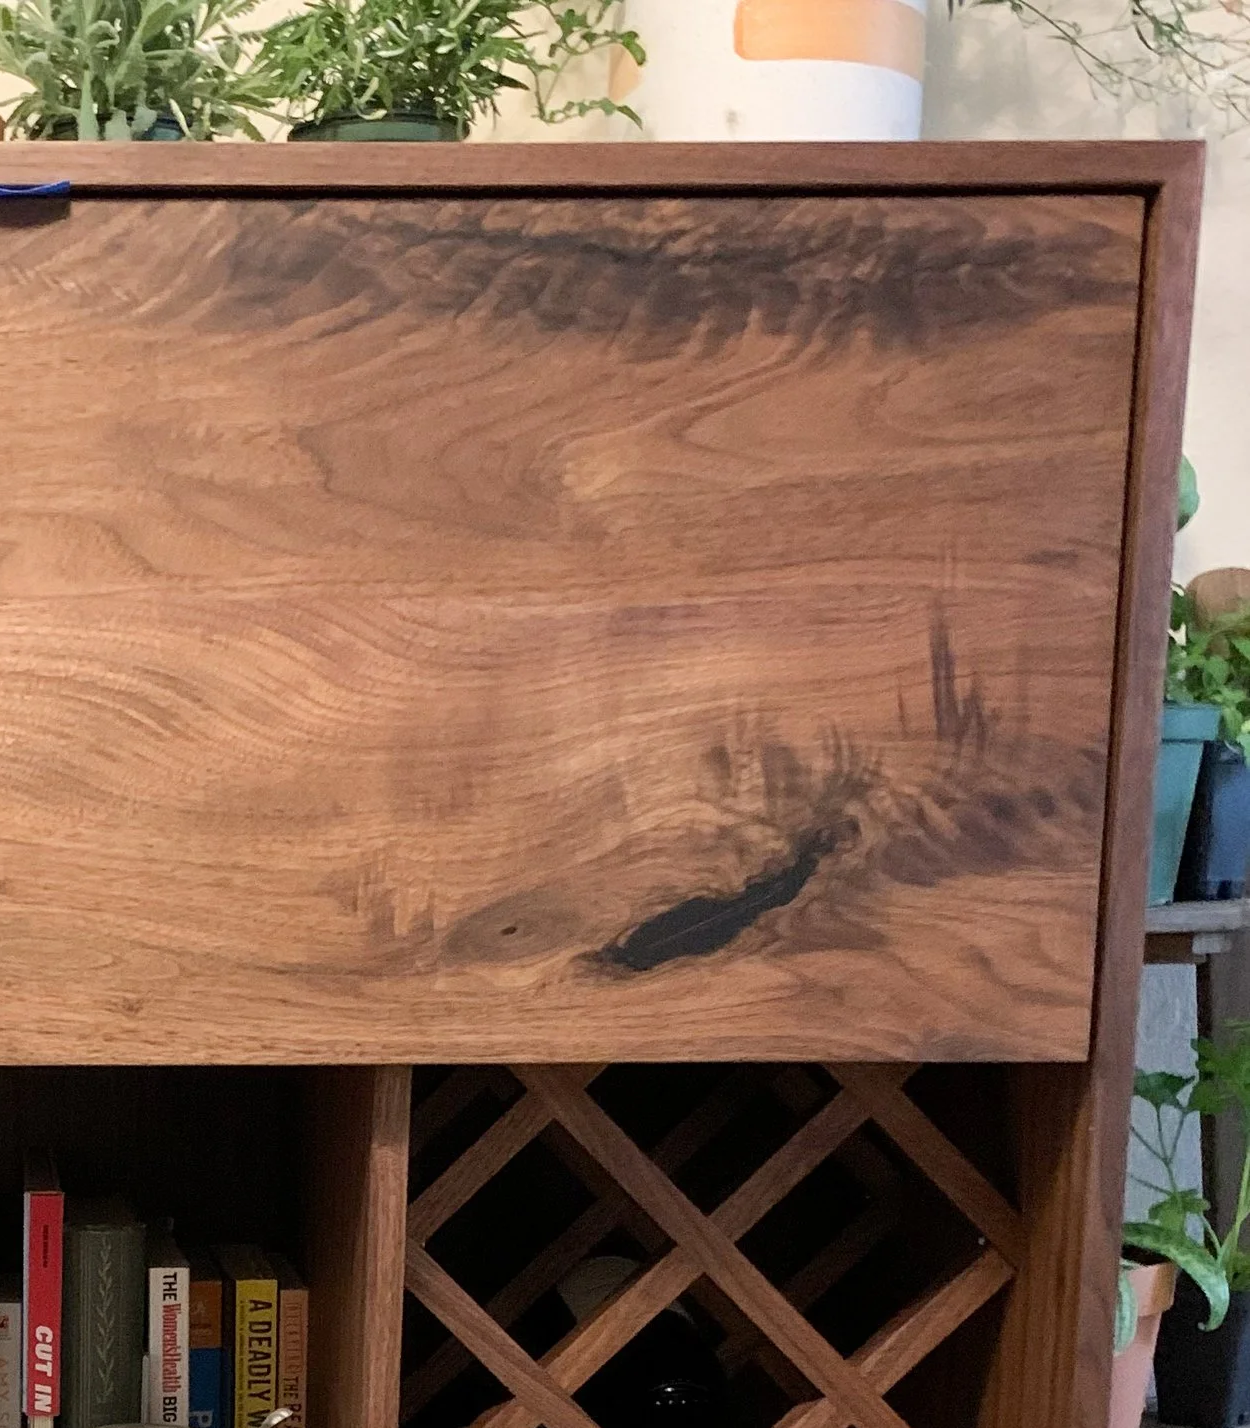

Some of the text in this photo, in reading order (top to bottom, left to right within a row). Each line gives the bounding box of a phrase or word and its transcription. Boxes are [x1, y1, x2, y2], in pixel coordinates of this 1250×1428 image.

[248, 1299, 273, 1313] A
[34, 1325, 54, 1377] CUT
[162, 1273, 178, 1424] THE BIG
[247, 1320, 273, 1402] DEADLY
[33, 1383, 54, 1413] IN
[282, 1376, 299, 1398] THE
